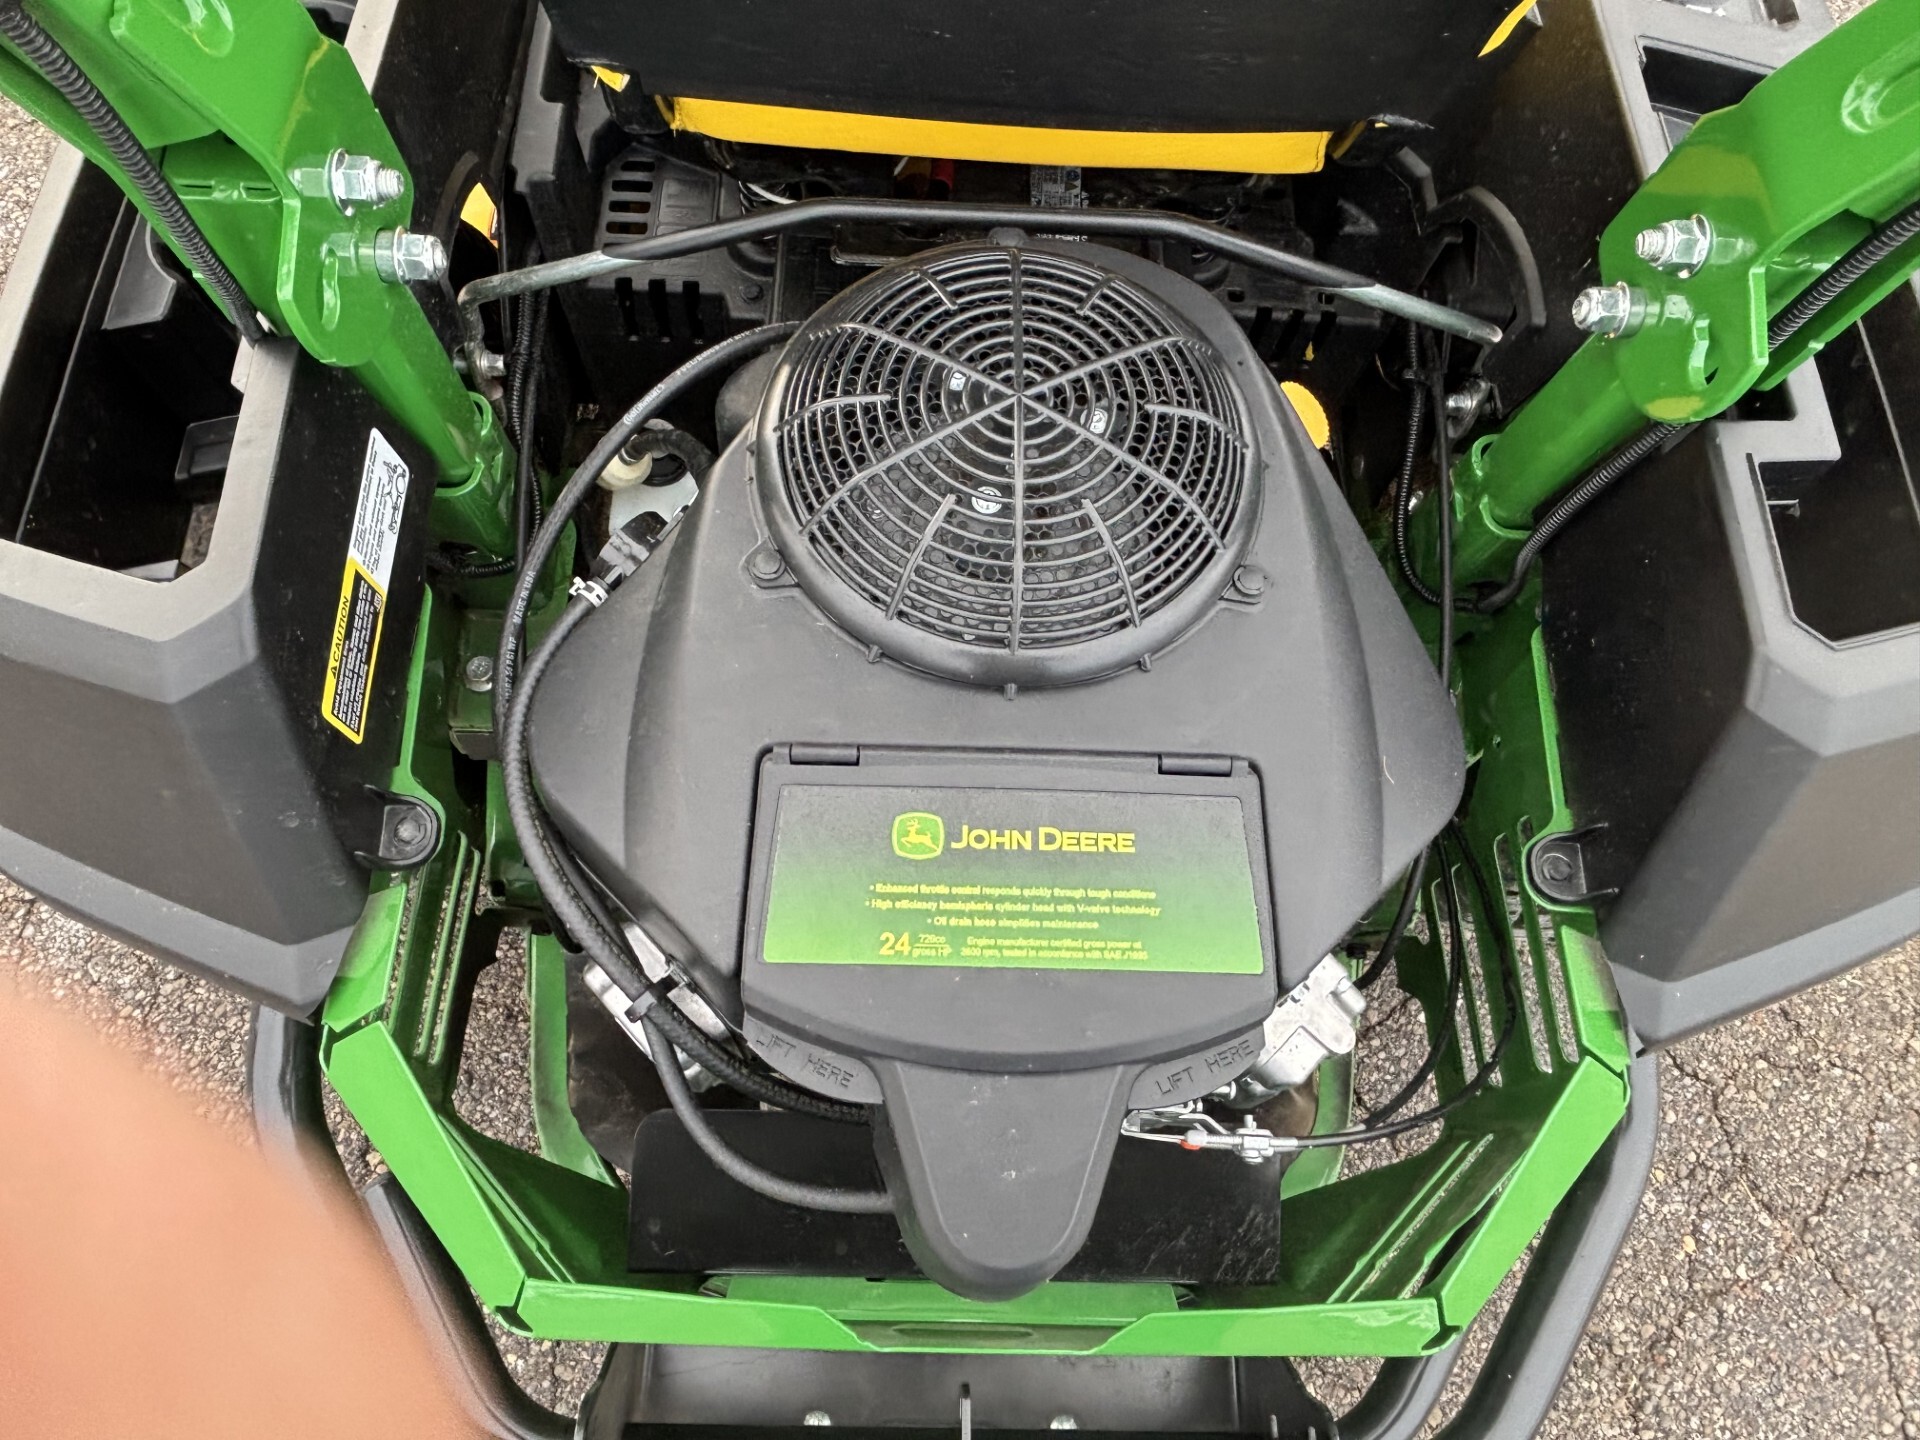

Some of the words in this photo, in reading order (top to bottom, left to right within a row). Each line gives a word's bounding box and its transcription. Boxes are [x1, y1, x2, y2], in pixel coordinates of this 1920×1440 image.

[523, 571, 536, 588] USA
[520, 588, 530, 599] IN
[512, 598, 526, 624] MADE
[332, 596, 349, 663] CAUTION
[950, 825, 1032, 851] JOHN
[1038, 826, 1136, 853] DEERE
[1023, 887, 1052, 898] quickly
[871, 899, 893, 910] High
[995, 901, 1030, 912] cylinder
[1056, 903, 1075, 913] with
[1112, 904, 1161, 916] technology
[949, 917, 972, 926] drain
[879, 932, 911, 956] 24
[801, 1053, 854, 1088] HERE
[1155, 1066, 1194, 1095] LIFT
[1204, 1040, 1254, 1073] HERE
